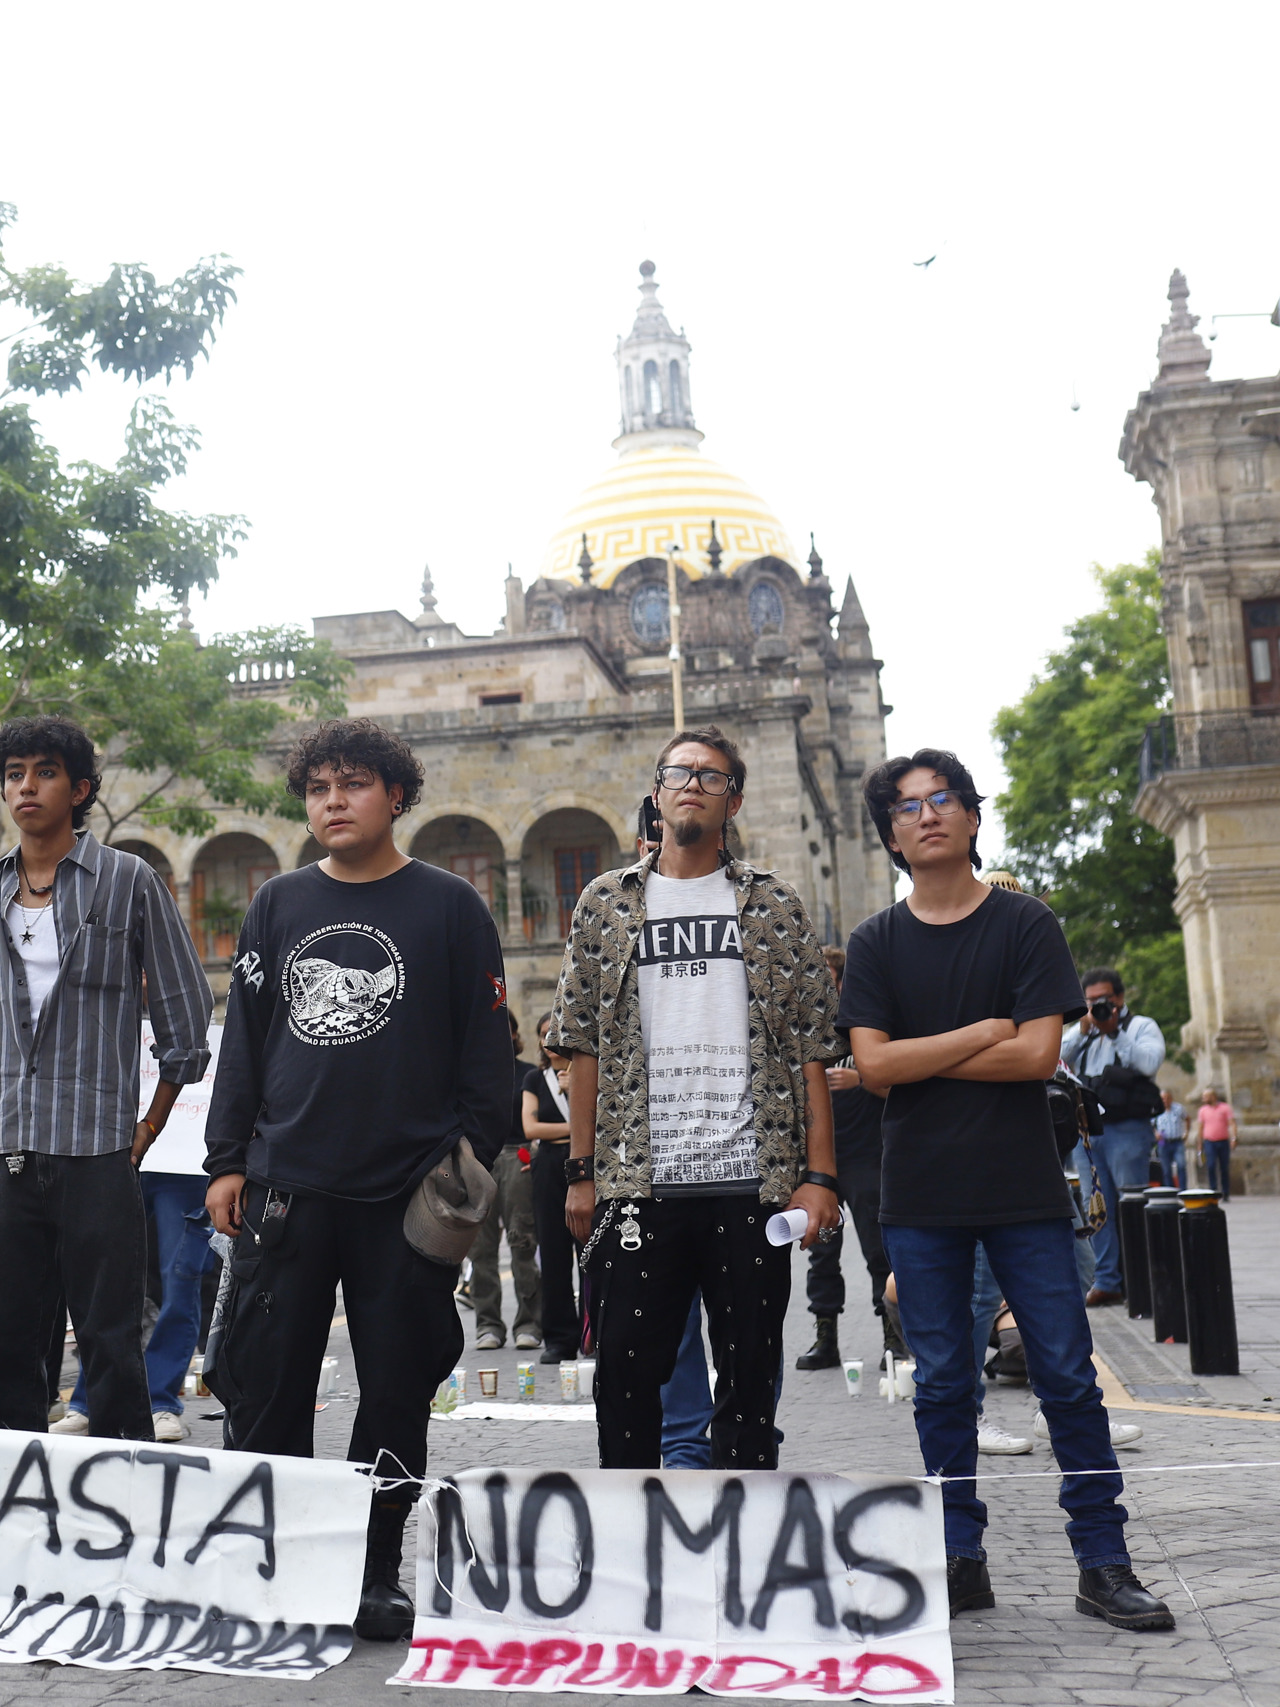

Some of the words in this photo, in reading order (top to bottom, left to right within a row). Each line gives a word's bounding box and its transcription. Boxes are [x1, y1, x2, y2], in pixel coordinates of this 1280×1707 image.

[300, 921, 362, 945] CONSERVACIÓN
[362, 924, 374, 933] DE
[373, 928, 402, 962] TORTUGAS
[395, 962, 406, 1000] MARINAS
[331, 1016, 391, 1046] GUADALAJARA
[431, 1470, 595, 1618] NO
[642, 1474, 928, 1642] MAS
[409, 1636, 942, 1697] IMPUNIDAD
